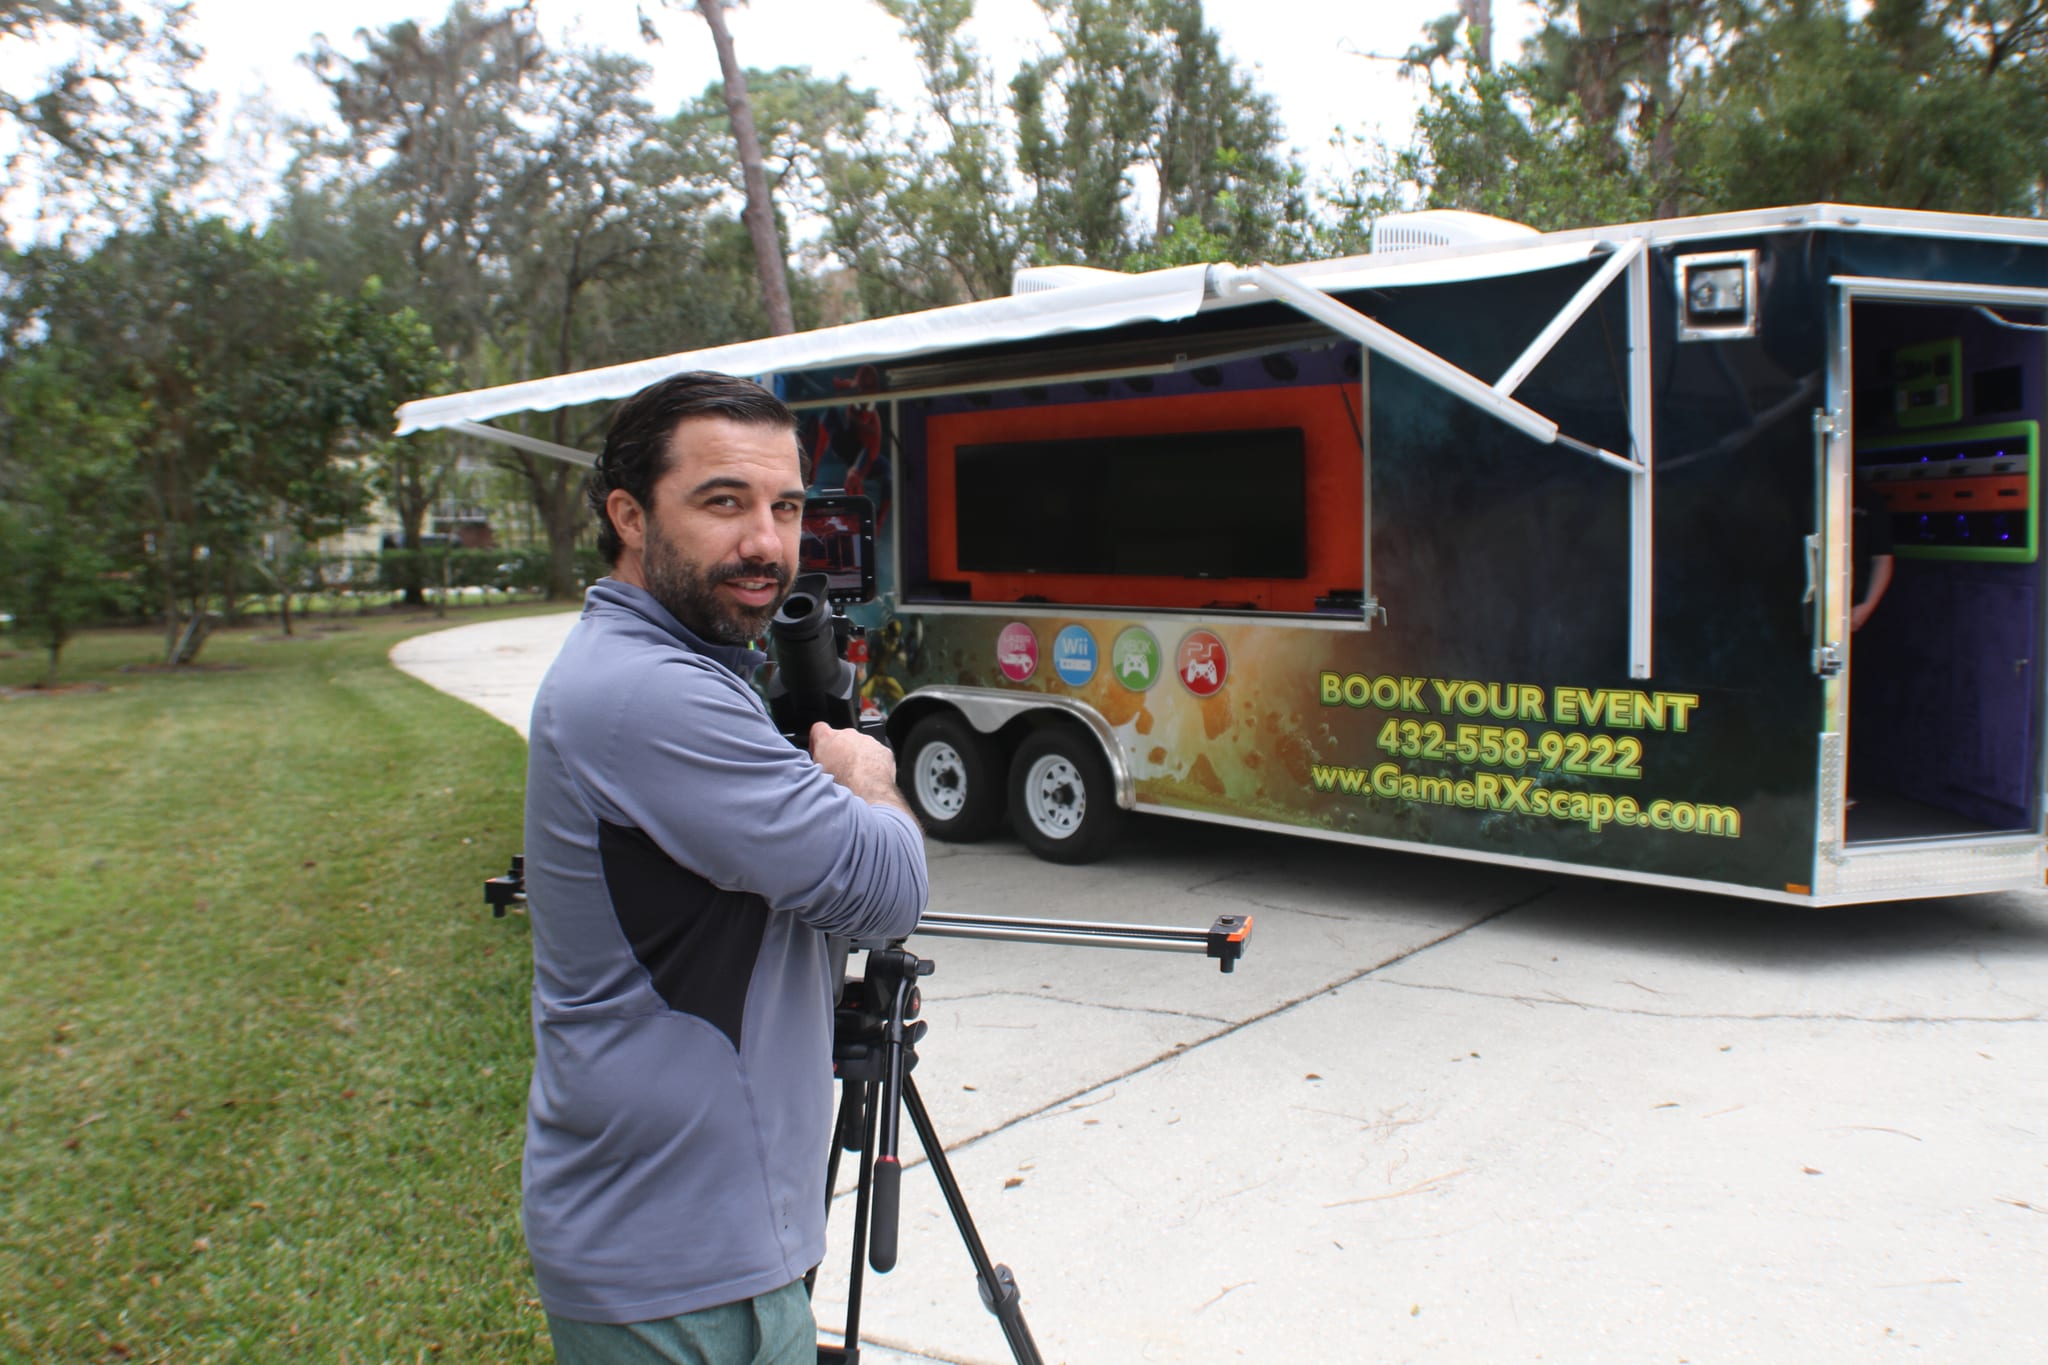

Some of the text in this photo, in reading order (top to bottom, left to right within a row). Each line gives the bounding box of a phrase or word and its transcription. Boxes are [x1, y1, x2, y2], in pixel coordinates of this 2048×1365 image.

[1062, 637, 1088, 656] Wii
[1121, 639, 1152, 654] XBOX
[1320, 671, 1699, 732] BOOK YOUR EVENT
[1377, 718, 1642, 779] 432-558-9222
